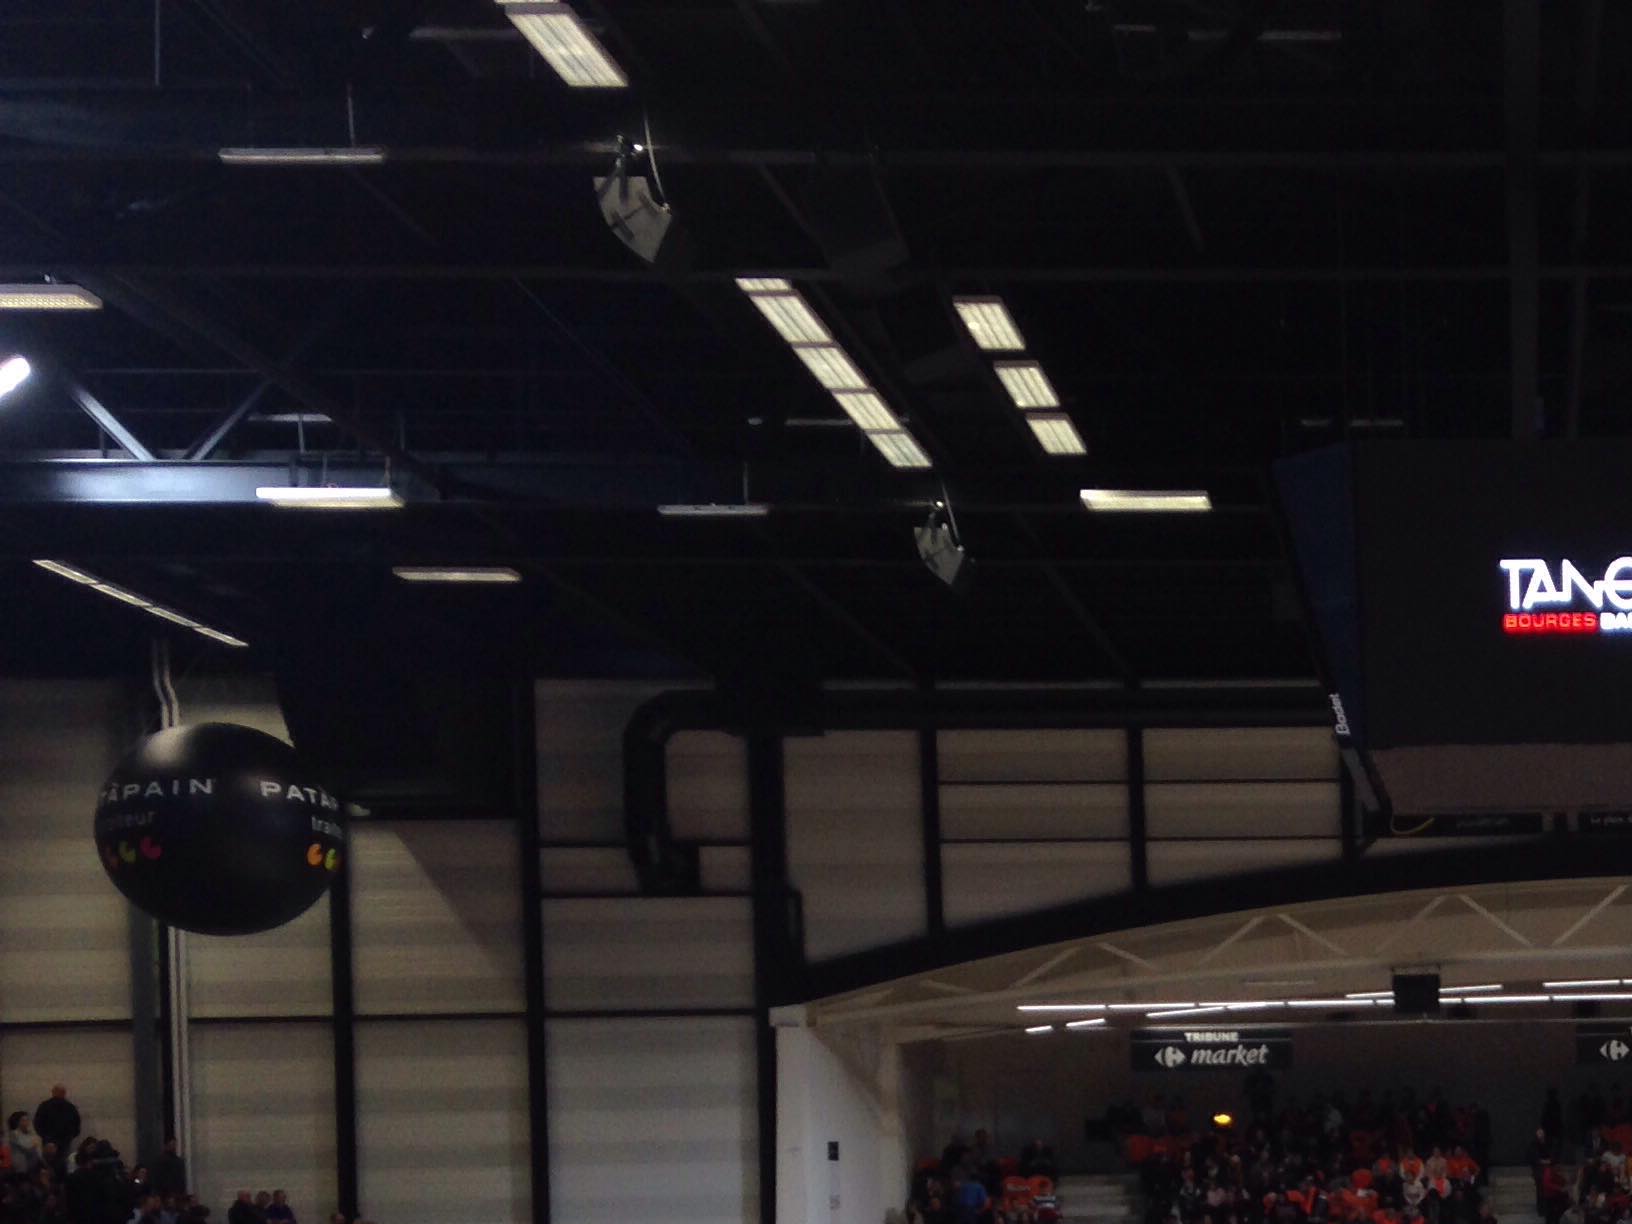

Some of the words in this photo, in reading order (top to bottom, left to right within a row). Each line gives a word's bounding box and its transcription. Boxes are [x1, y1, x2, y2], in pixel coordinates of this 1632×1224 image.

[1503, 613, 1597, 631] BOURGES
[1184, 1032, 1240, 1043] TRIBUNE
[1190, 1044, 1269, 1067] market
